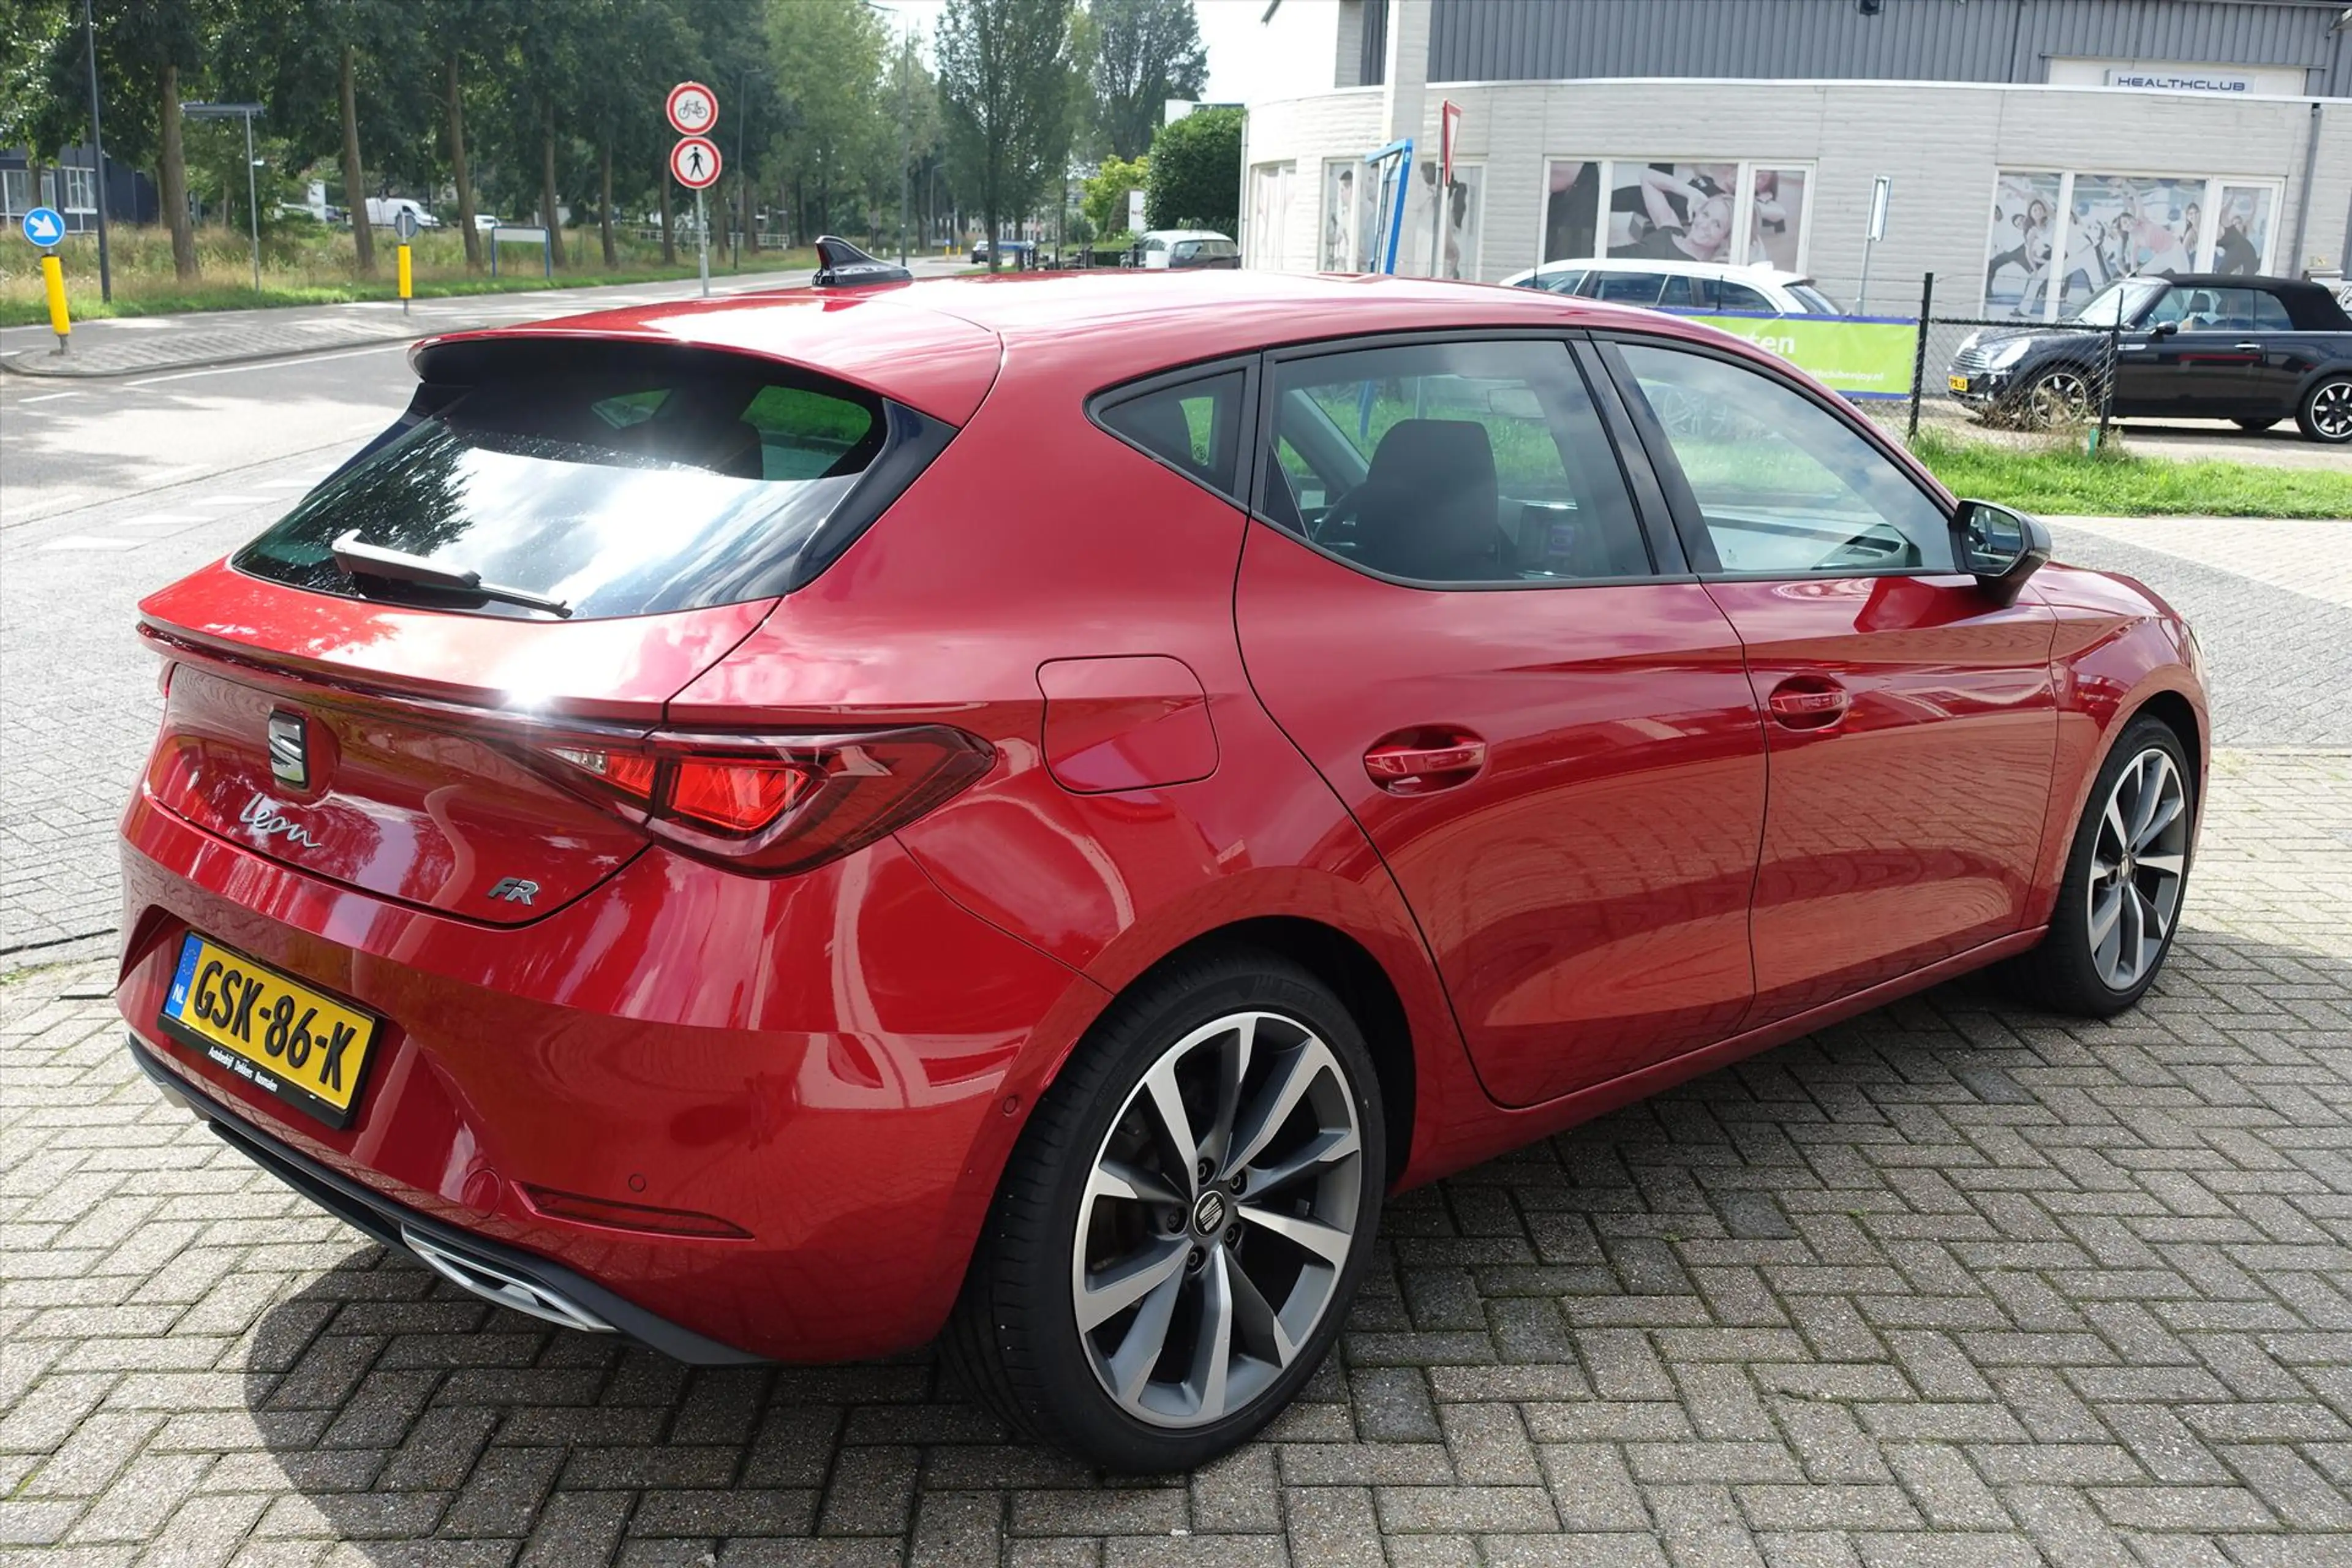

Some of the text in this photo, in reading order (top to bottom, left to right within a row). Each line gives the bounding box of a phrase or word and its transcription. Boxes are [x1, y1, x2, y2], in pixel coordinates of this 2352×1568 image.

[2117, 77, 2245, 91] HEALTHCLUB
[488, 876, 541, 907] FR
[172, 983, 184, 1004] NL
[193, 960, 357, 1092] GSK-86-K
